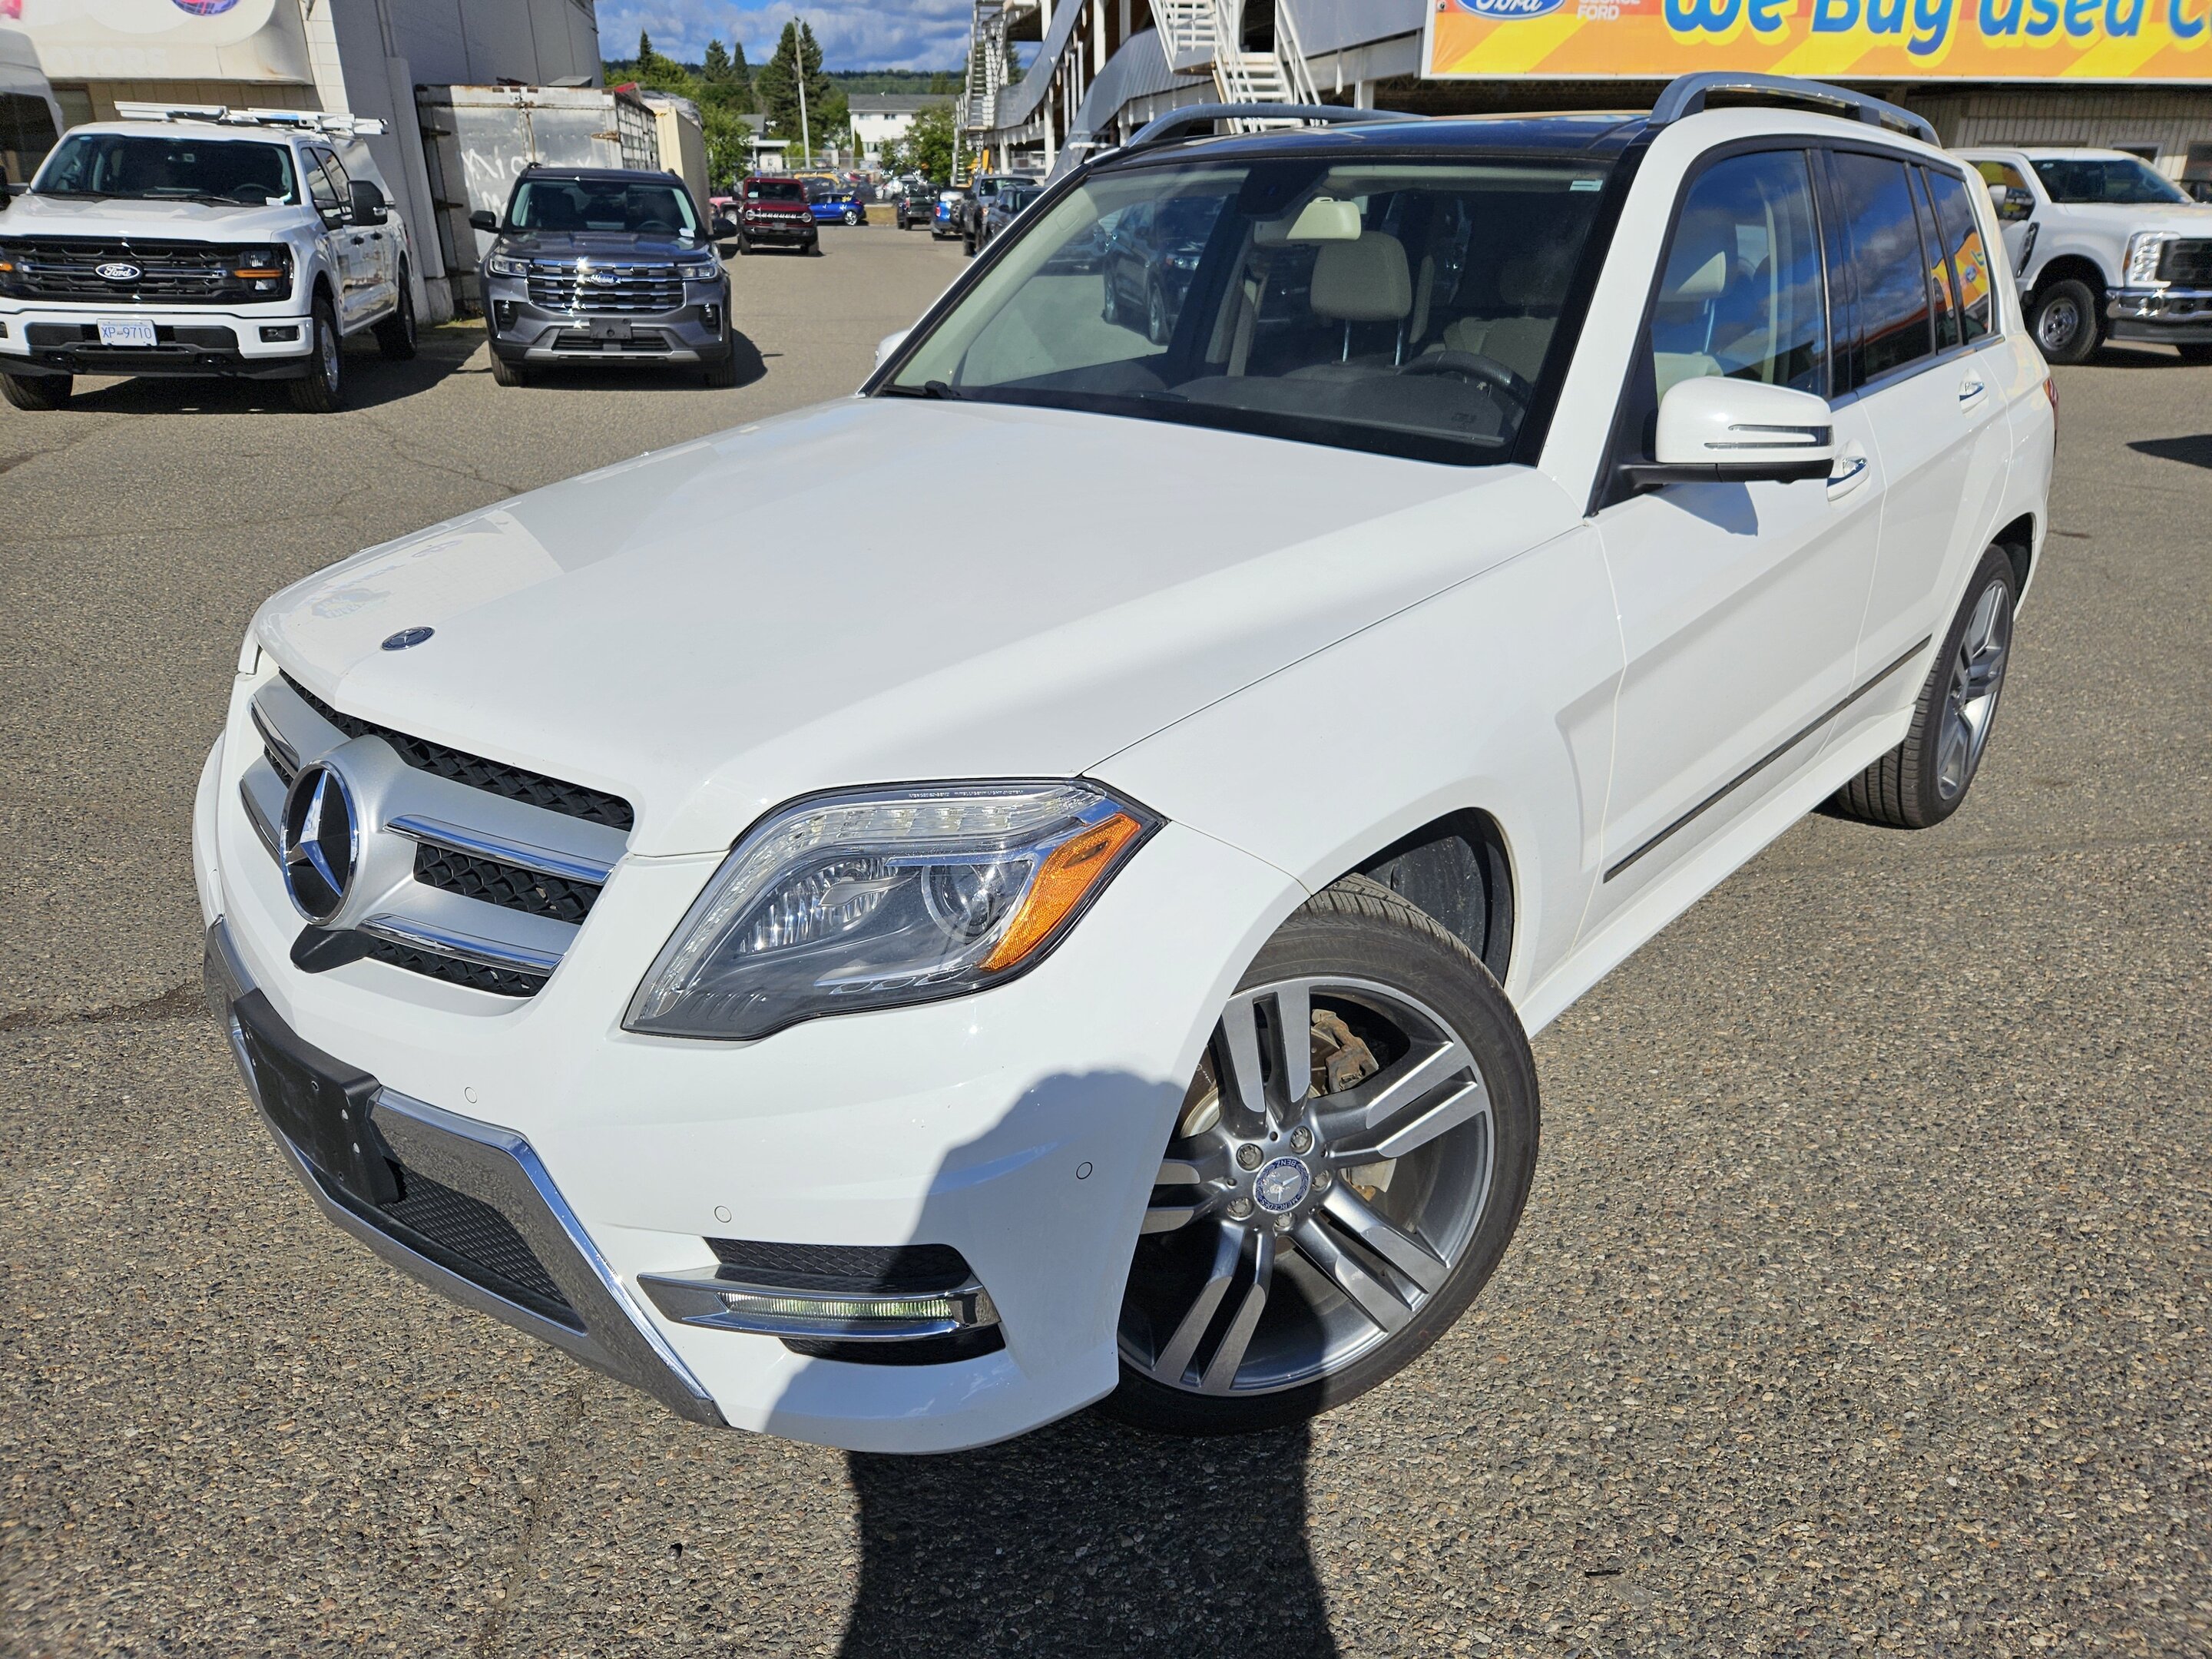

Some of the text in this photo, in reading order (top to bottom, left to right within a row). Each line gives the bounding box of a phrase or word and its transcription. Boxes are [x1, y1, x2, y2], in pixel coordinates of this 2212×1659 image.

[1576, 5, 1621, 21] FORD
[104, 265, 132, 276] Ford
[1275, 1159, 1297, 1167] BENZ
[1260, 1196, 1299, 1210] MERCEDES
